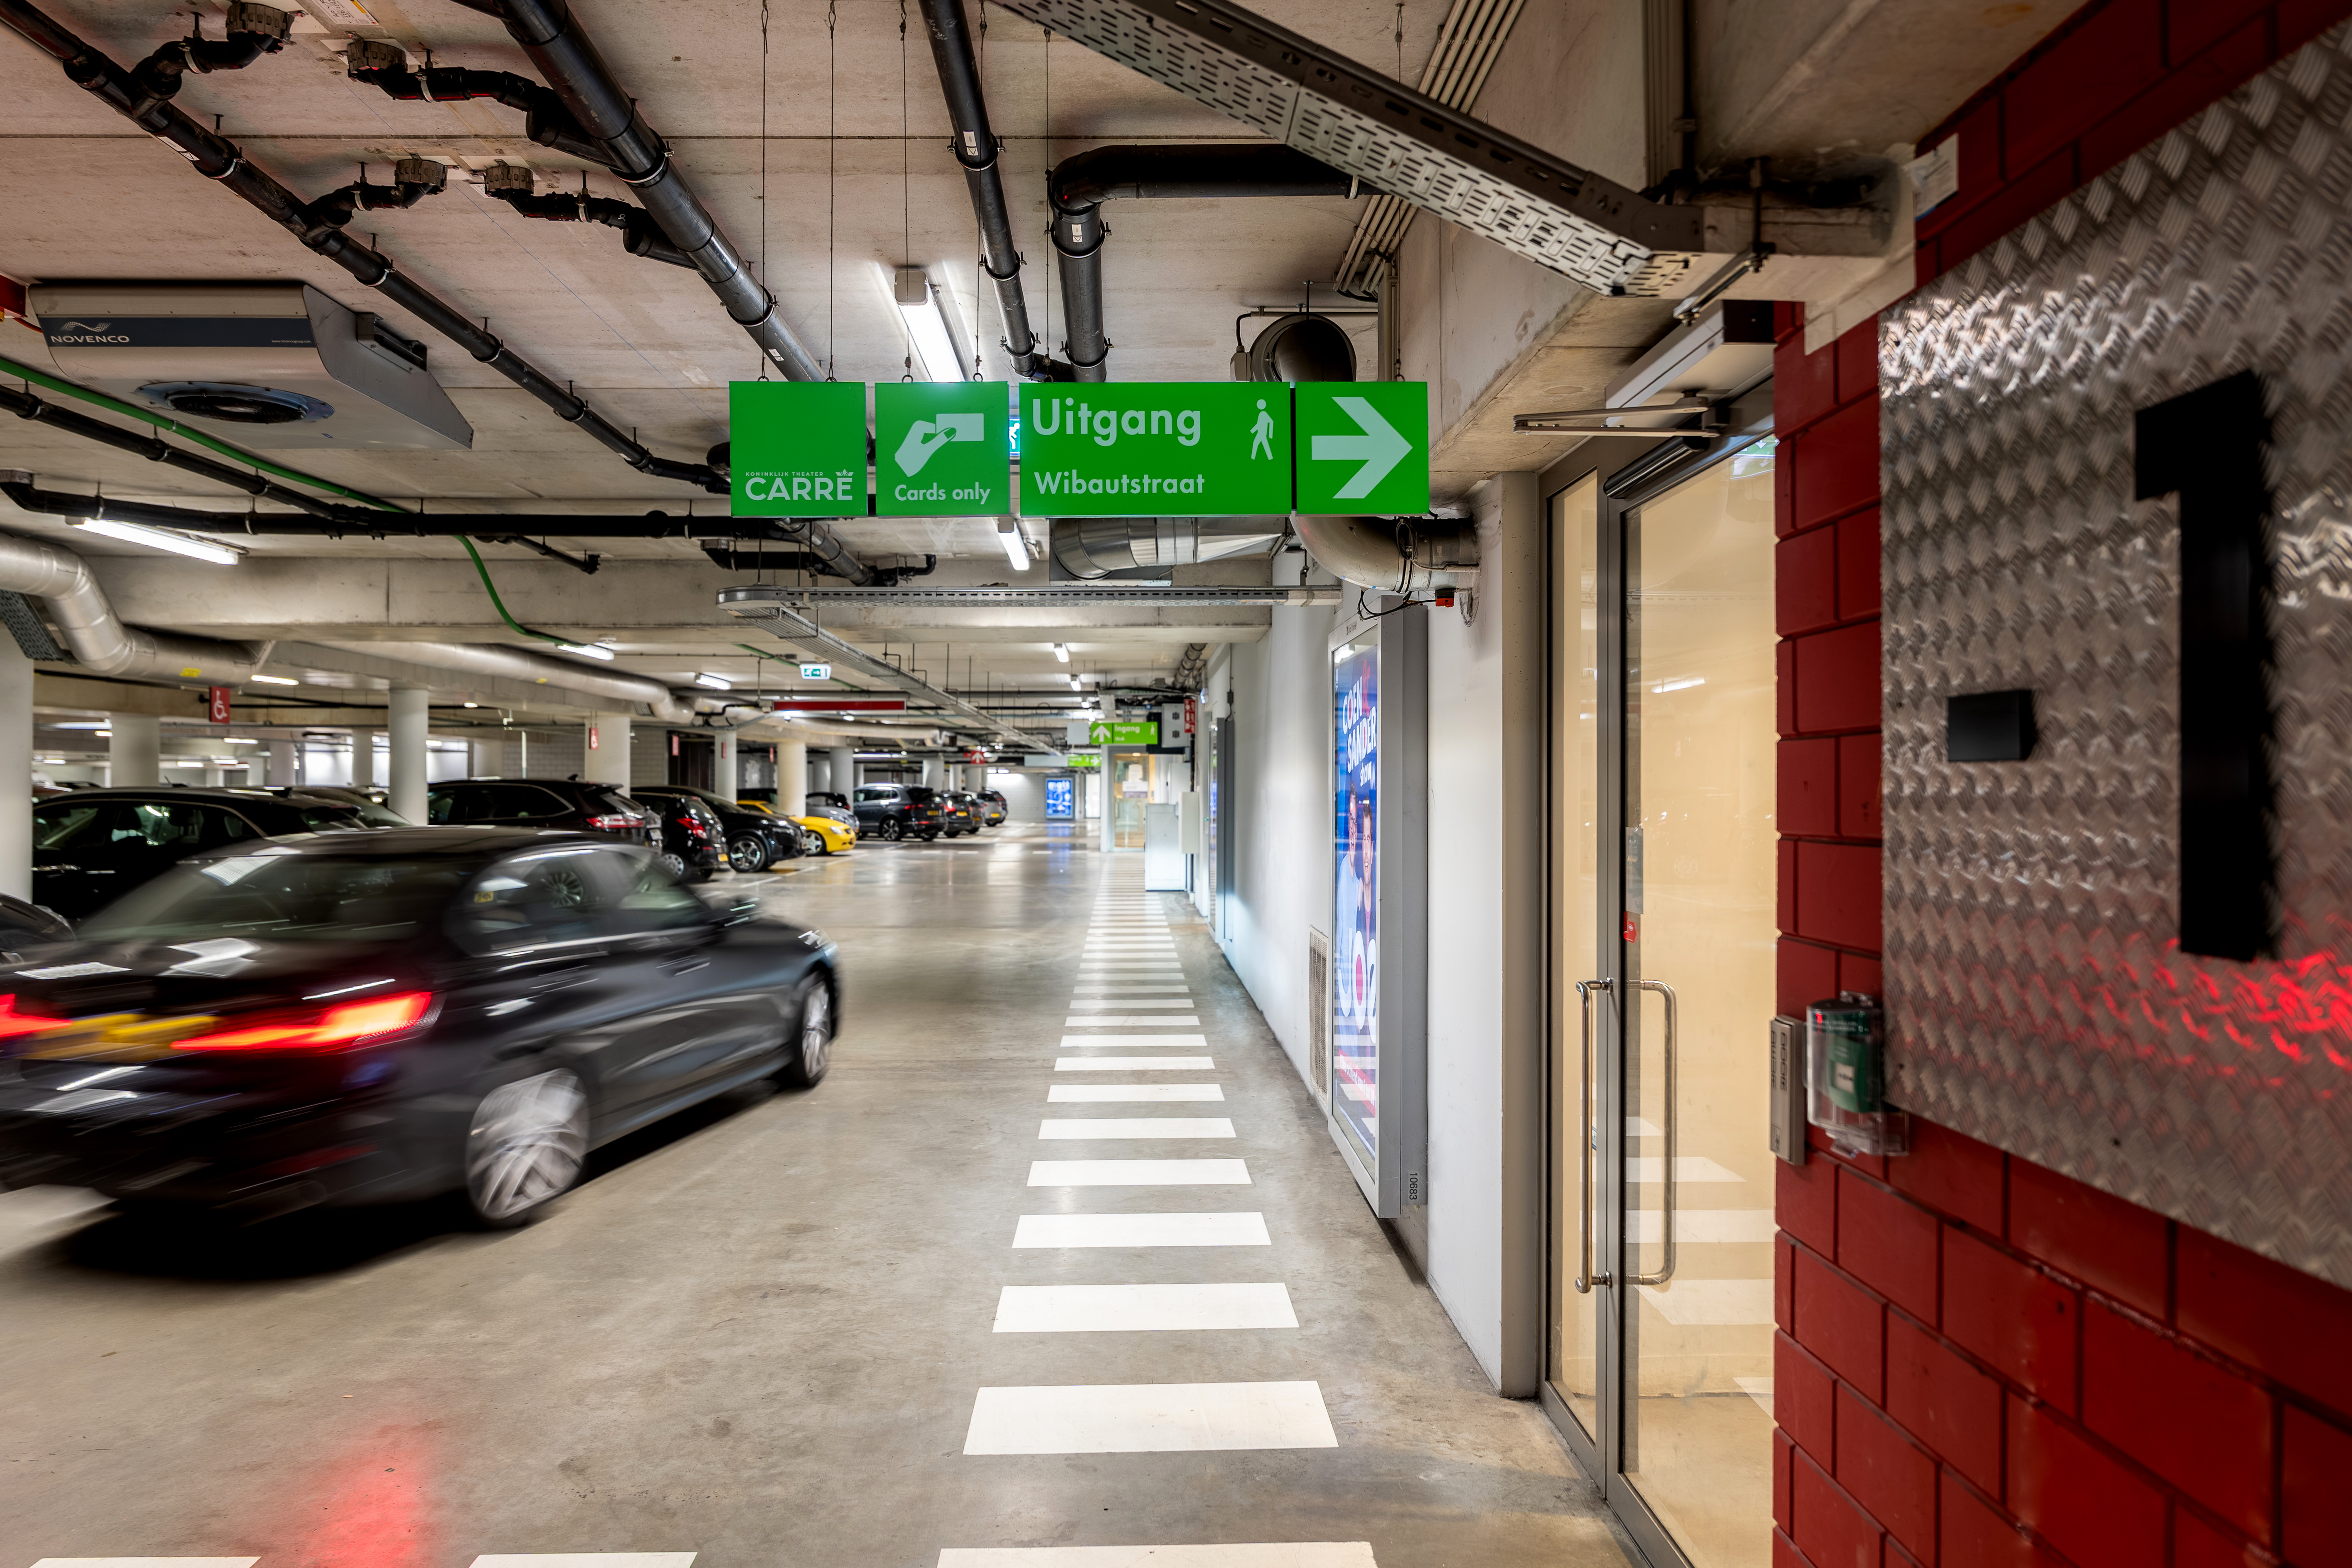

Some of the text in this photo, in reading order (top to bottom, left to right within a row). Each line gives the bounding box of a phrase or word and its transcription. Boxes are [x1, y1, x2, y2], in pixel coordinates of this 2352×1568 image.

[1033, 397, 1201, 446] Uitgang
[895, 482, 991, 505] Cards only
[1034, 469, 1205, 494] Wibautstraat
[1343, 675, 1362, 735] COEN
[1115, 725, 1140, 733] Ingang
[1347, 706, 1376, 773] SANDER
[1360, 761, 1372, 787] show
[1409, 1172, 1418, 1200] 10683
